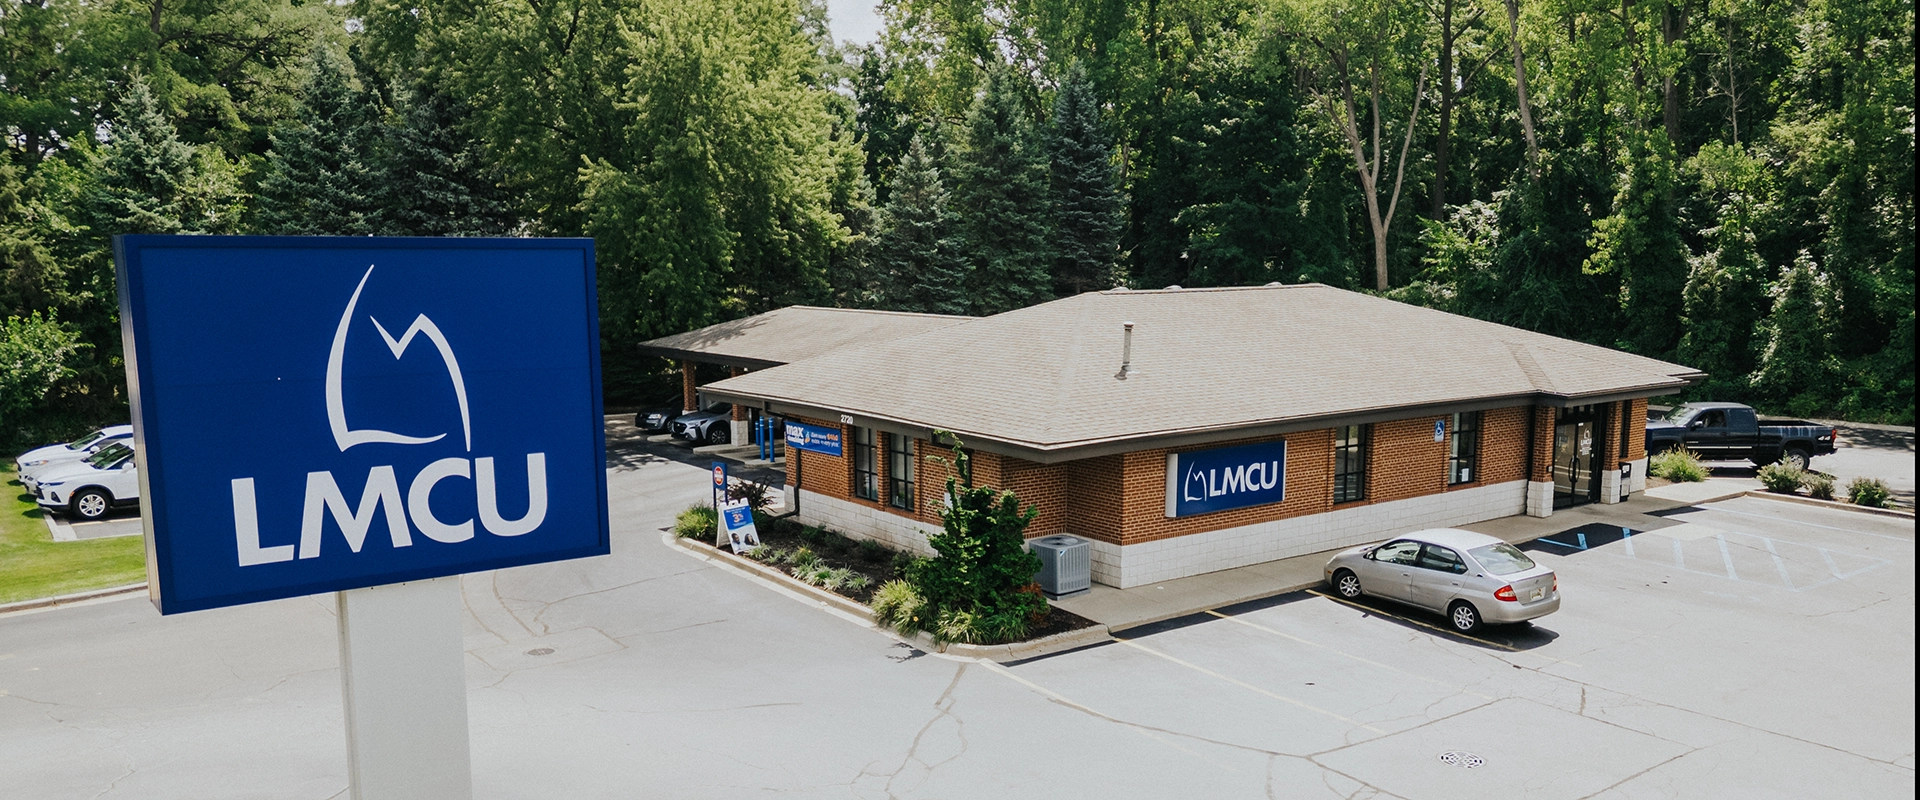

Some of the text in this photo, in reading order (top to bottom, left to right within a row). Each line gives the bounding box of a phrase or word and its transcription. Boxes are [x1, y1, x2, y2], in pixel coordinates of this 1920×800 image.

[786, 424, 804, 438] max
[841, 414, 853, 425] 2720
[1209, 461, 1278, 497] LMCU
[231, 452, 548, 567] LMCU
